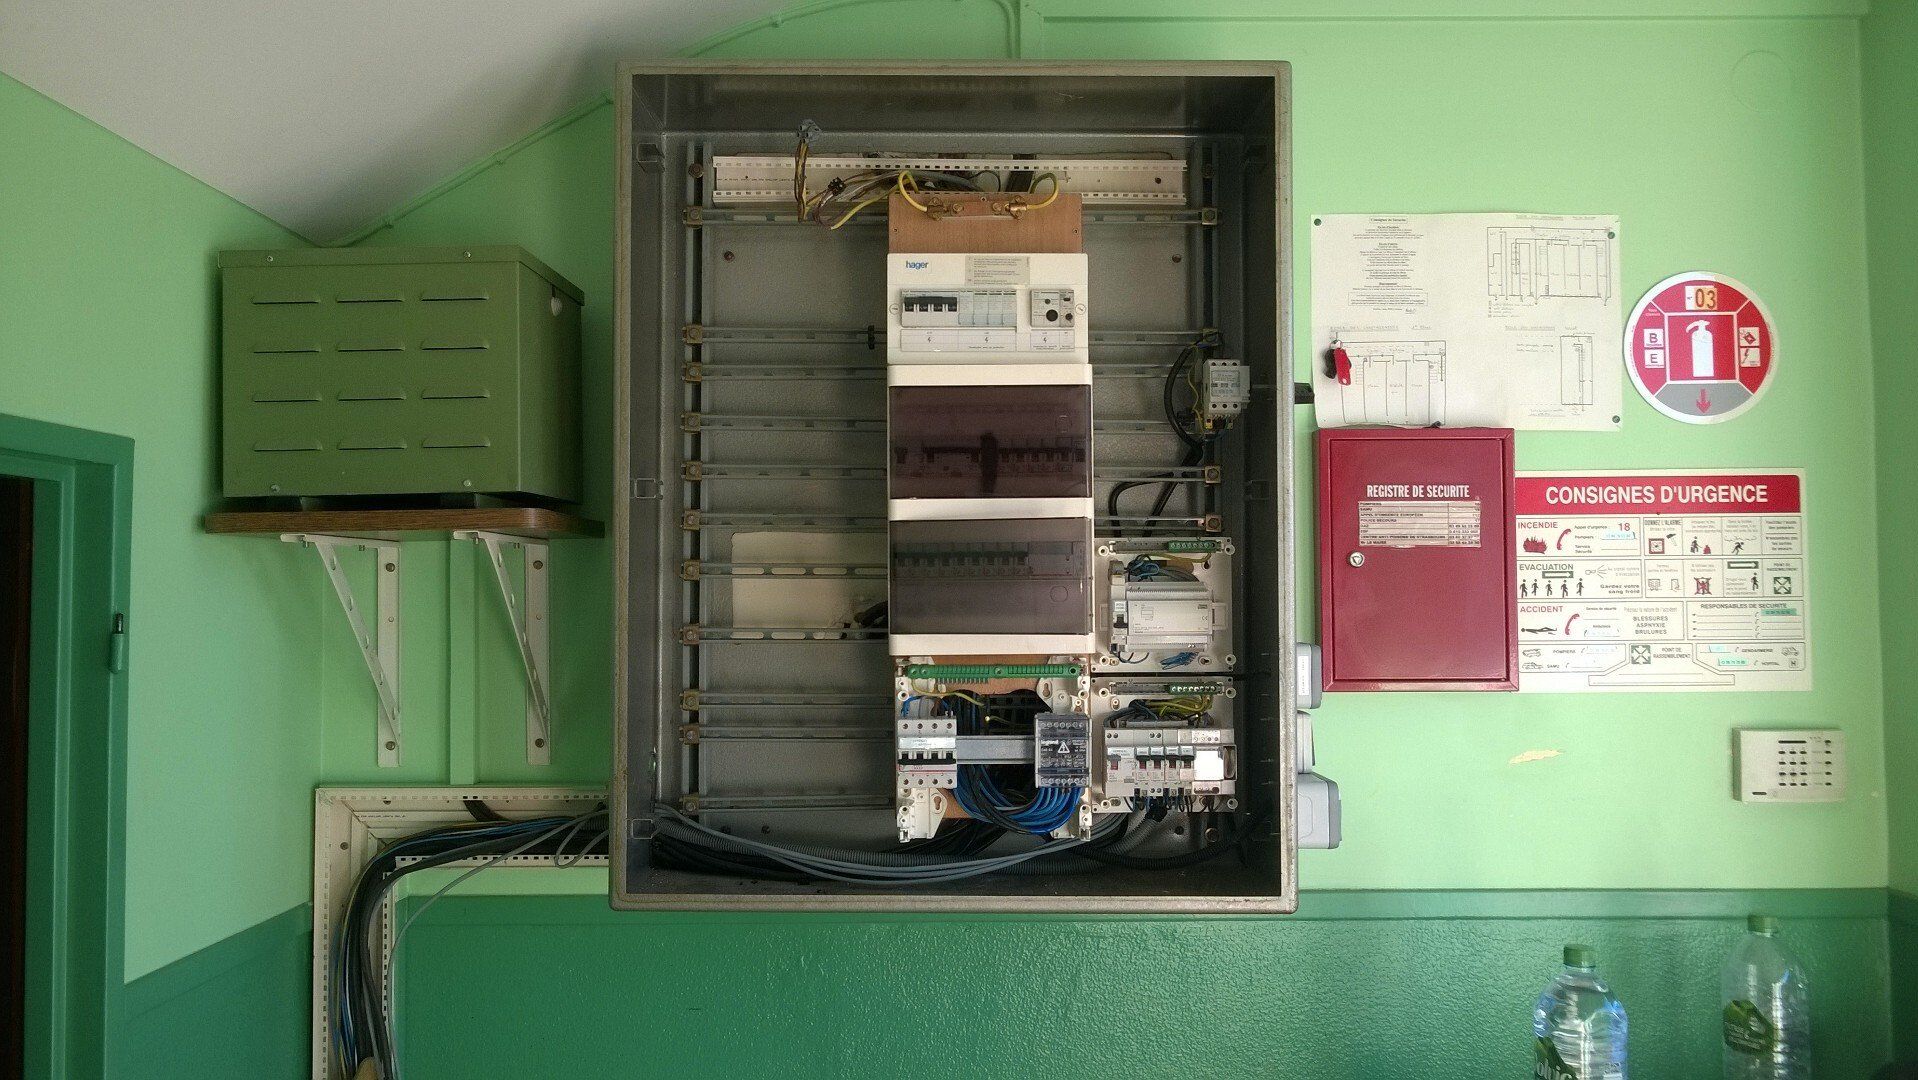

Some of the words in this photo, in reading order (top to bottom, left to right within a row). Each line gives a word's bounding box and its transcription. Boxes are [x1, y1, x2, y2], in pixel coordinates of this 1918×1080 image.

[905, 260, 929, 270] hager
[1695, 288, 1717, 310] 03
[1649, 333, 1658, 343] B
[1650, 354, 1658, 363] E
[1366, 484, 1410, 498] REGISTRE
[1412, 484, 1423, 498] DE
[1427, 484, 1470, 498] SECURITE
[1546, 485, 1655, 505] CONSIGNES
[1660, 484, 1768, 504] D'URGENCE
[1617, 523, 1631, 531] 18
